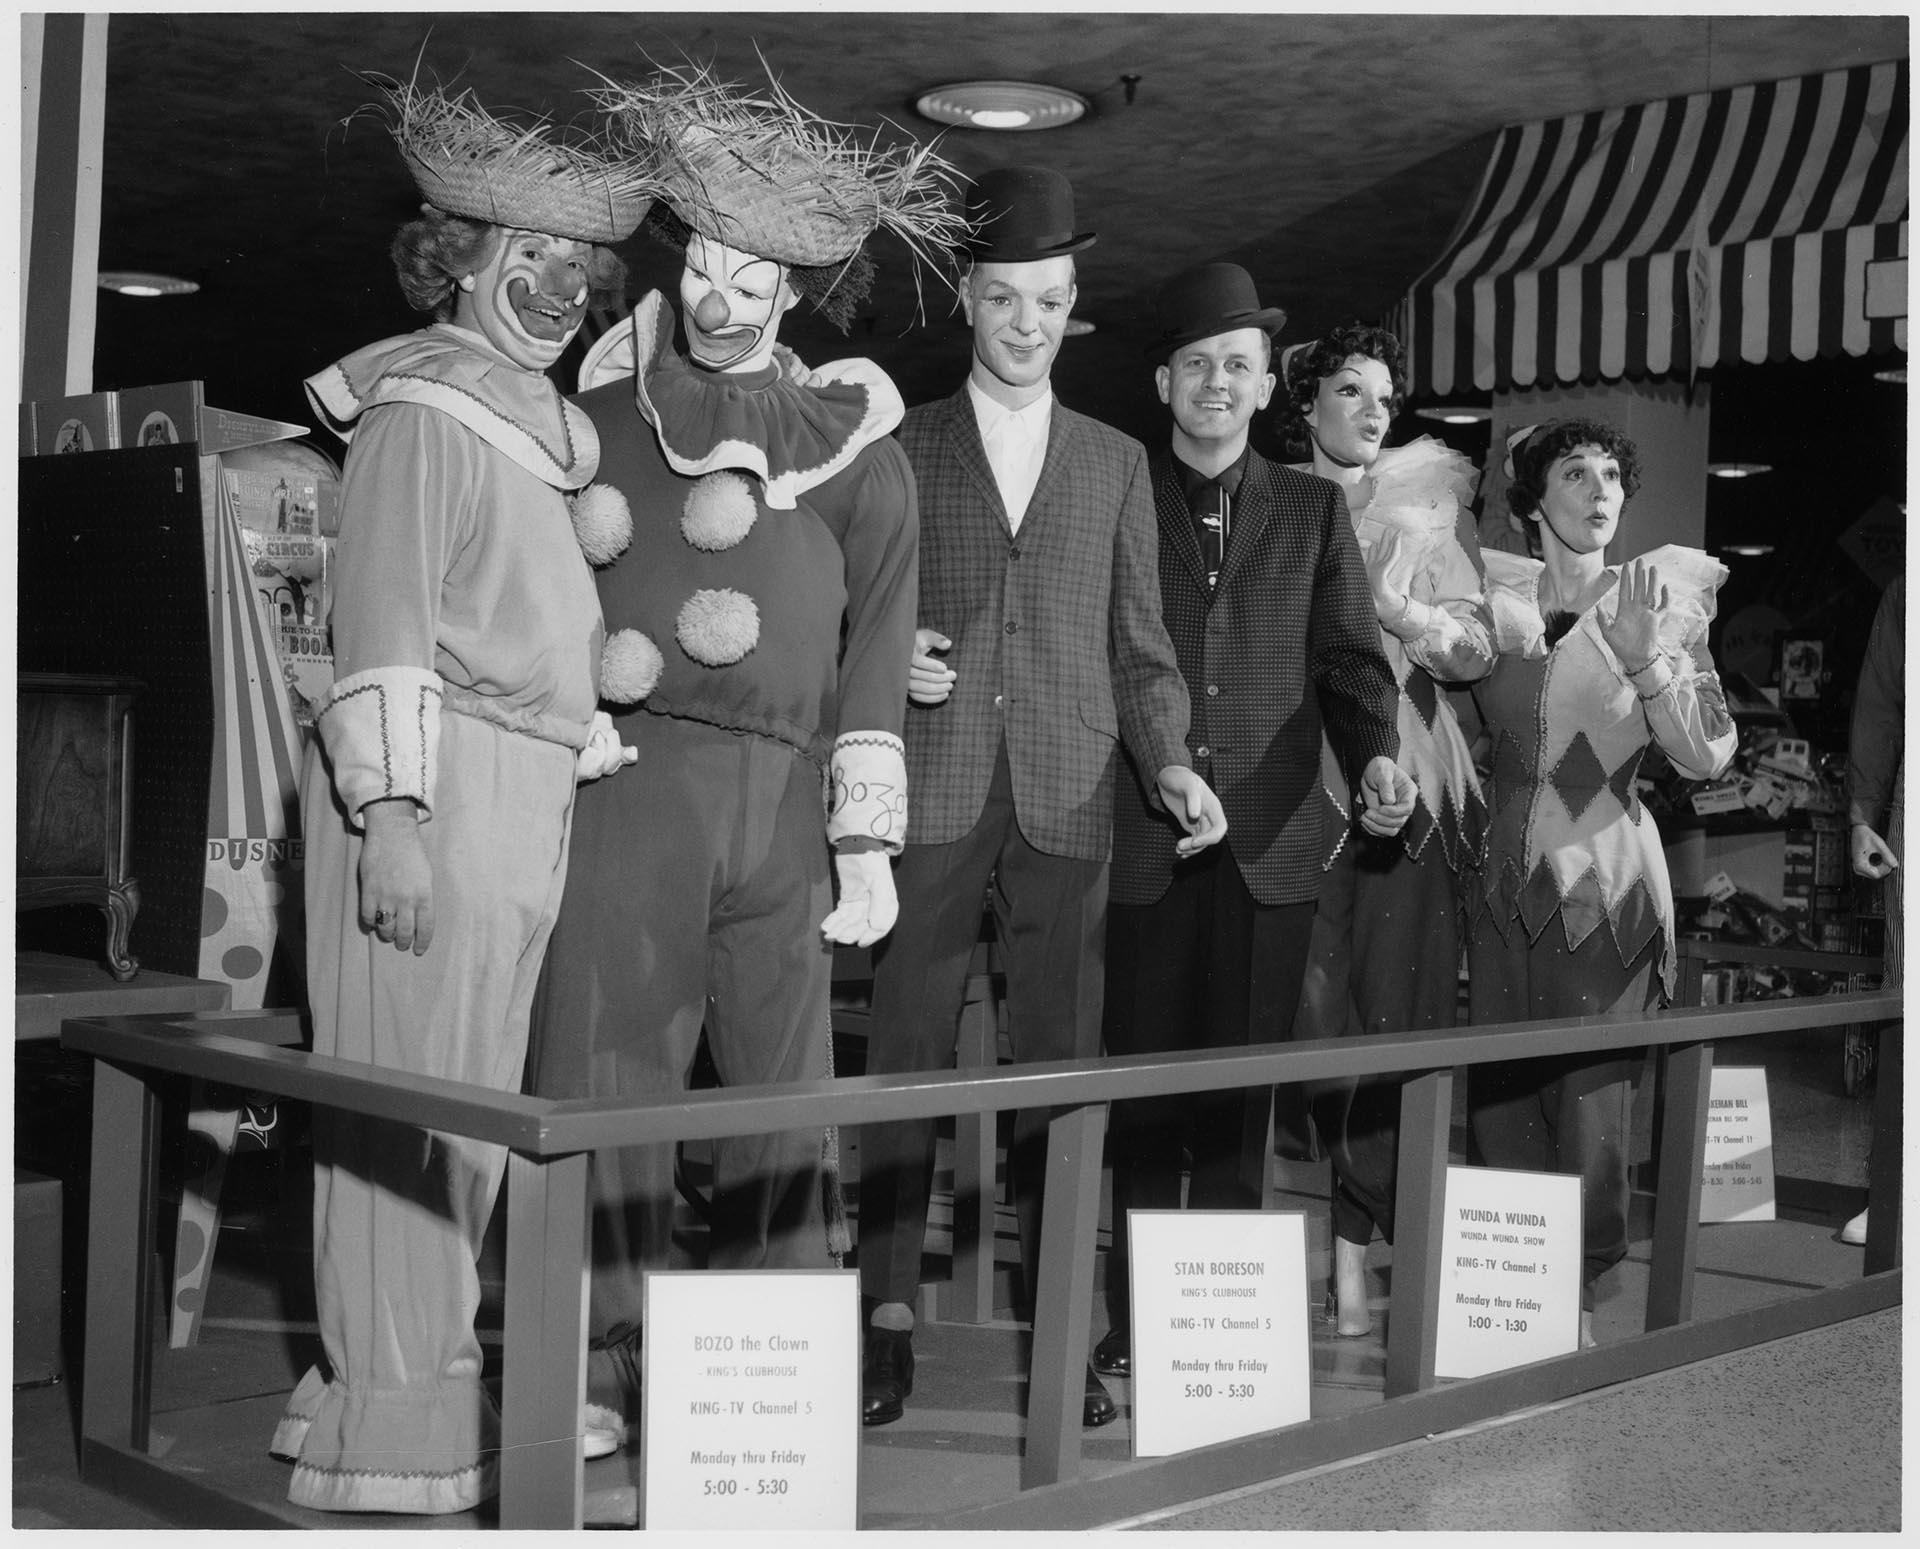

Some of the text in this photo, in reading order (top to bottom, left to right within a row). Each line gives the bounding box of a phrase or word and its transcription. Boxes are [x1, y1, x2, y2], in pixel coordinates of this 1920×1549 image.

[266, 542, 314, 556] CIRCUS
[209, 841, 305, 862] DISNE
[1735, 1099, 1749, 1108] BILL
[1723, 1136, 1744, 1144] Channel
[1746, 1136, 1753, 1144] 11
[1704, 1161, 1752, 1171] onday thru Friday
[1459, 1208, 1547, 1228] WUNDA WUNDA
[1460, 1231, 1546, 1246] WUNDA WUNDA SHOW
[1174, 1262, 1265, 1276] STAN BORESON
[1456, 1256, 1548, 1275] KING-TV Channel 5
[1181, 1288, 1257, 1297] KING'S CLUBHOUSE
[1455, 1292, 1542, 1312] Monday thru Friday
[1170, 1317, 1272, 1330] KING-TV Channel 5
[1468, 1315, 1492, 1329] 1:00
[1505, 1318, 1528, 1332] 1:30
[694, 1335, 809, 1352] BOZO the Clown
[706, 1366, 798, 1377] KING'S CLUBHOUSE
[1171, 1359, 1268, 1374] Monday thru Friday
[1184, 1384, 1213, 1398] 5:00
[1228, 1384, 1255, 1398] 5:30
[690, 1400, 813, 1416] KING-TV Channel 5
[690, 1449, 806, 1467] Monday thru Friday
[703, 1479, 738, 1496] 5:00
[756, 1478, 789, 1496] 5:30
